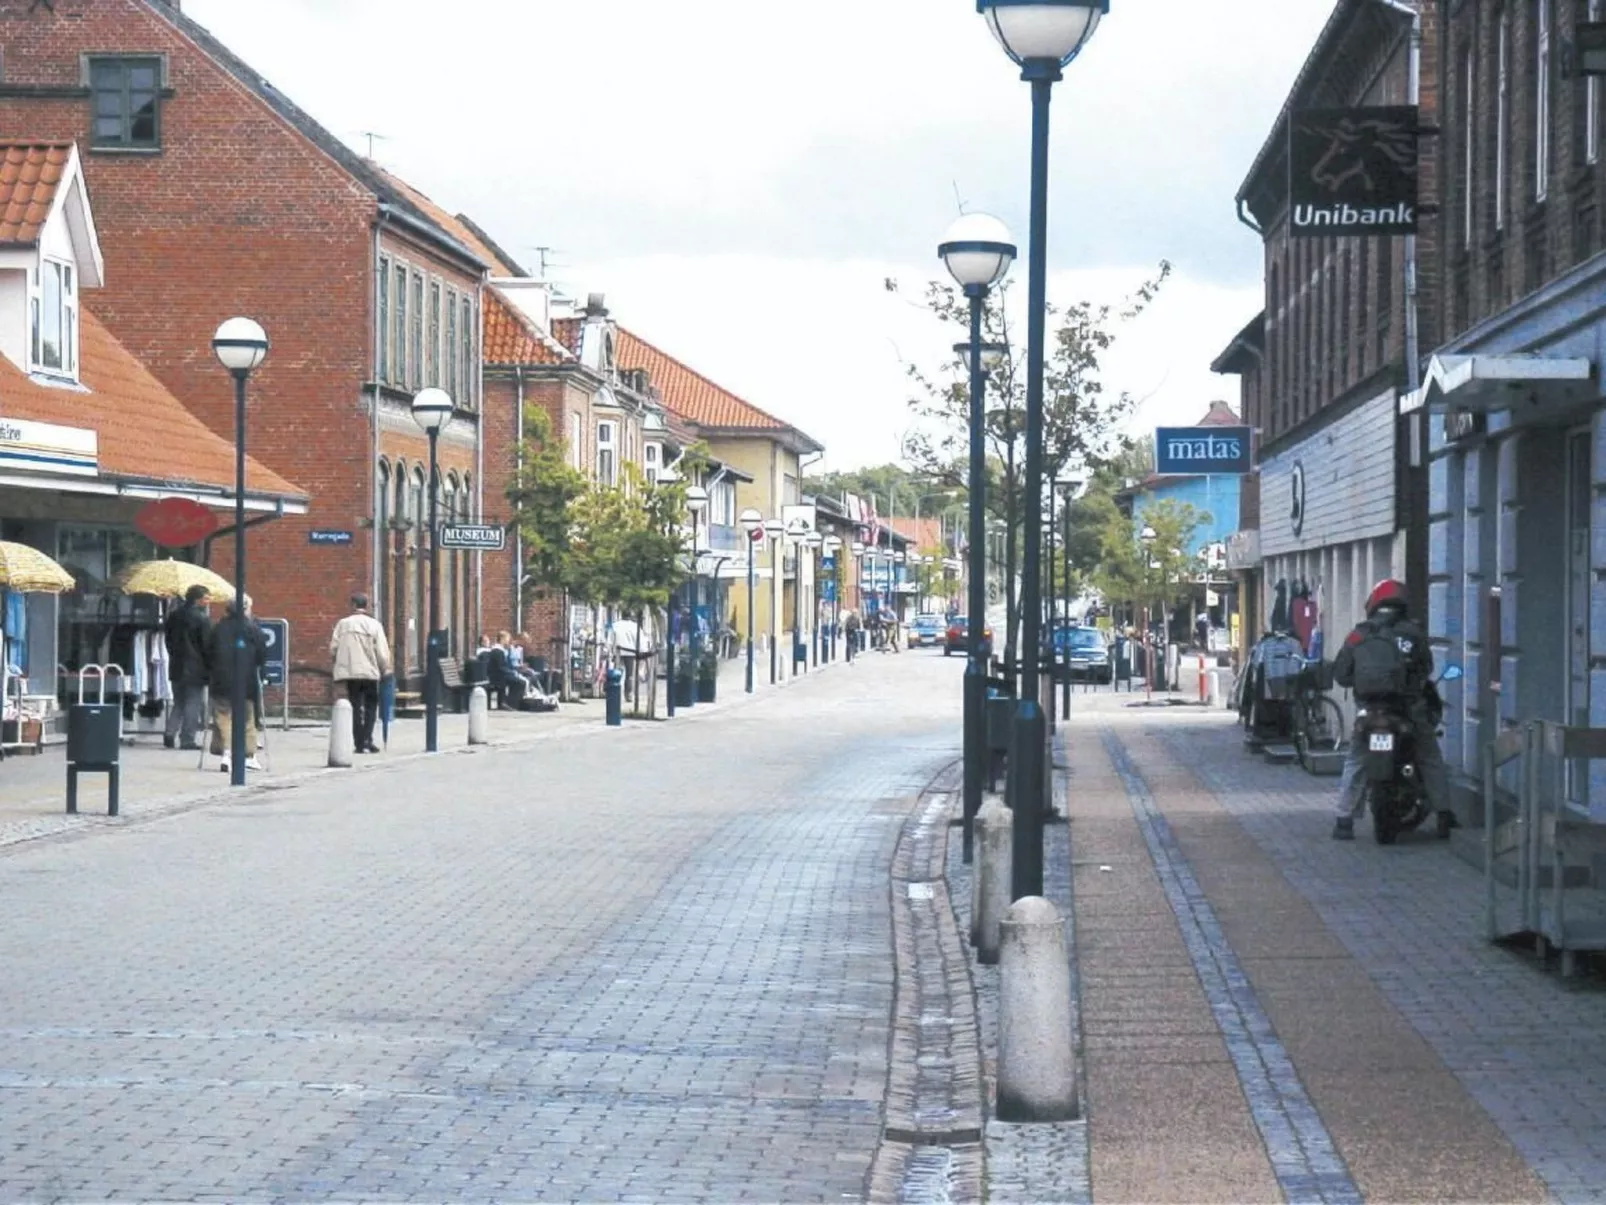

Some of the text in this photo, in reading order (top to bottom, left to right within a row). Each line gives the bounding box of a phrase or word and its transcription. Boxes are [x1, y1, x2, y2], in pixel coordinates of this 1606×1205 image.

[1294, 202, 1413, 226] Unibank
[1168, 433, 1241, 459] matas
[444, 528, 500, 541] MUSEUM
